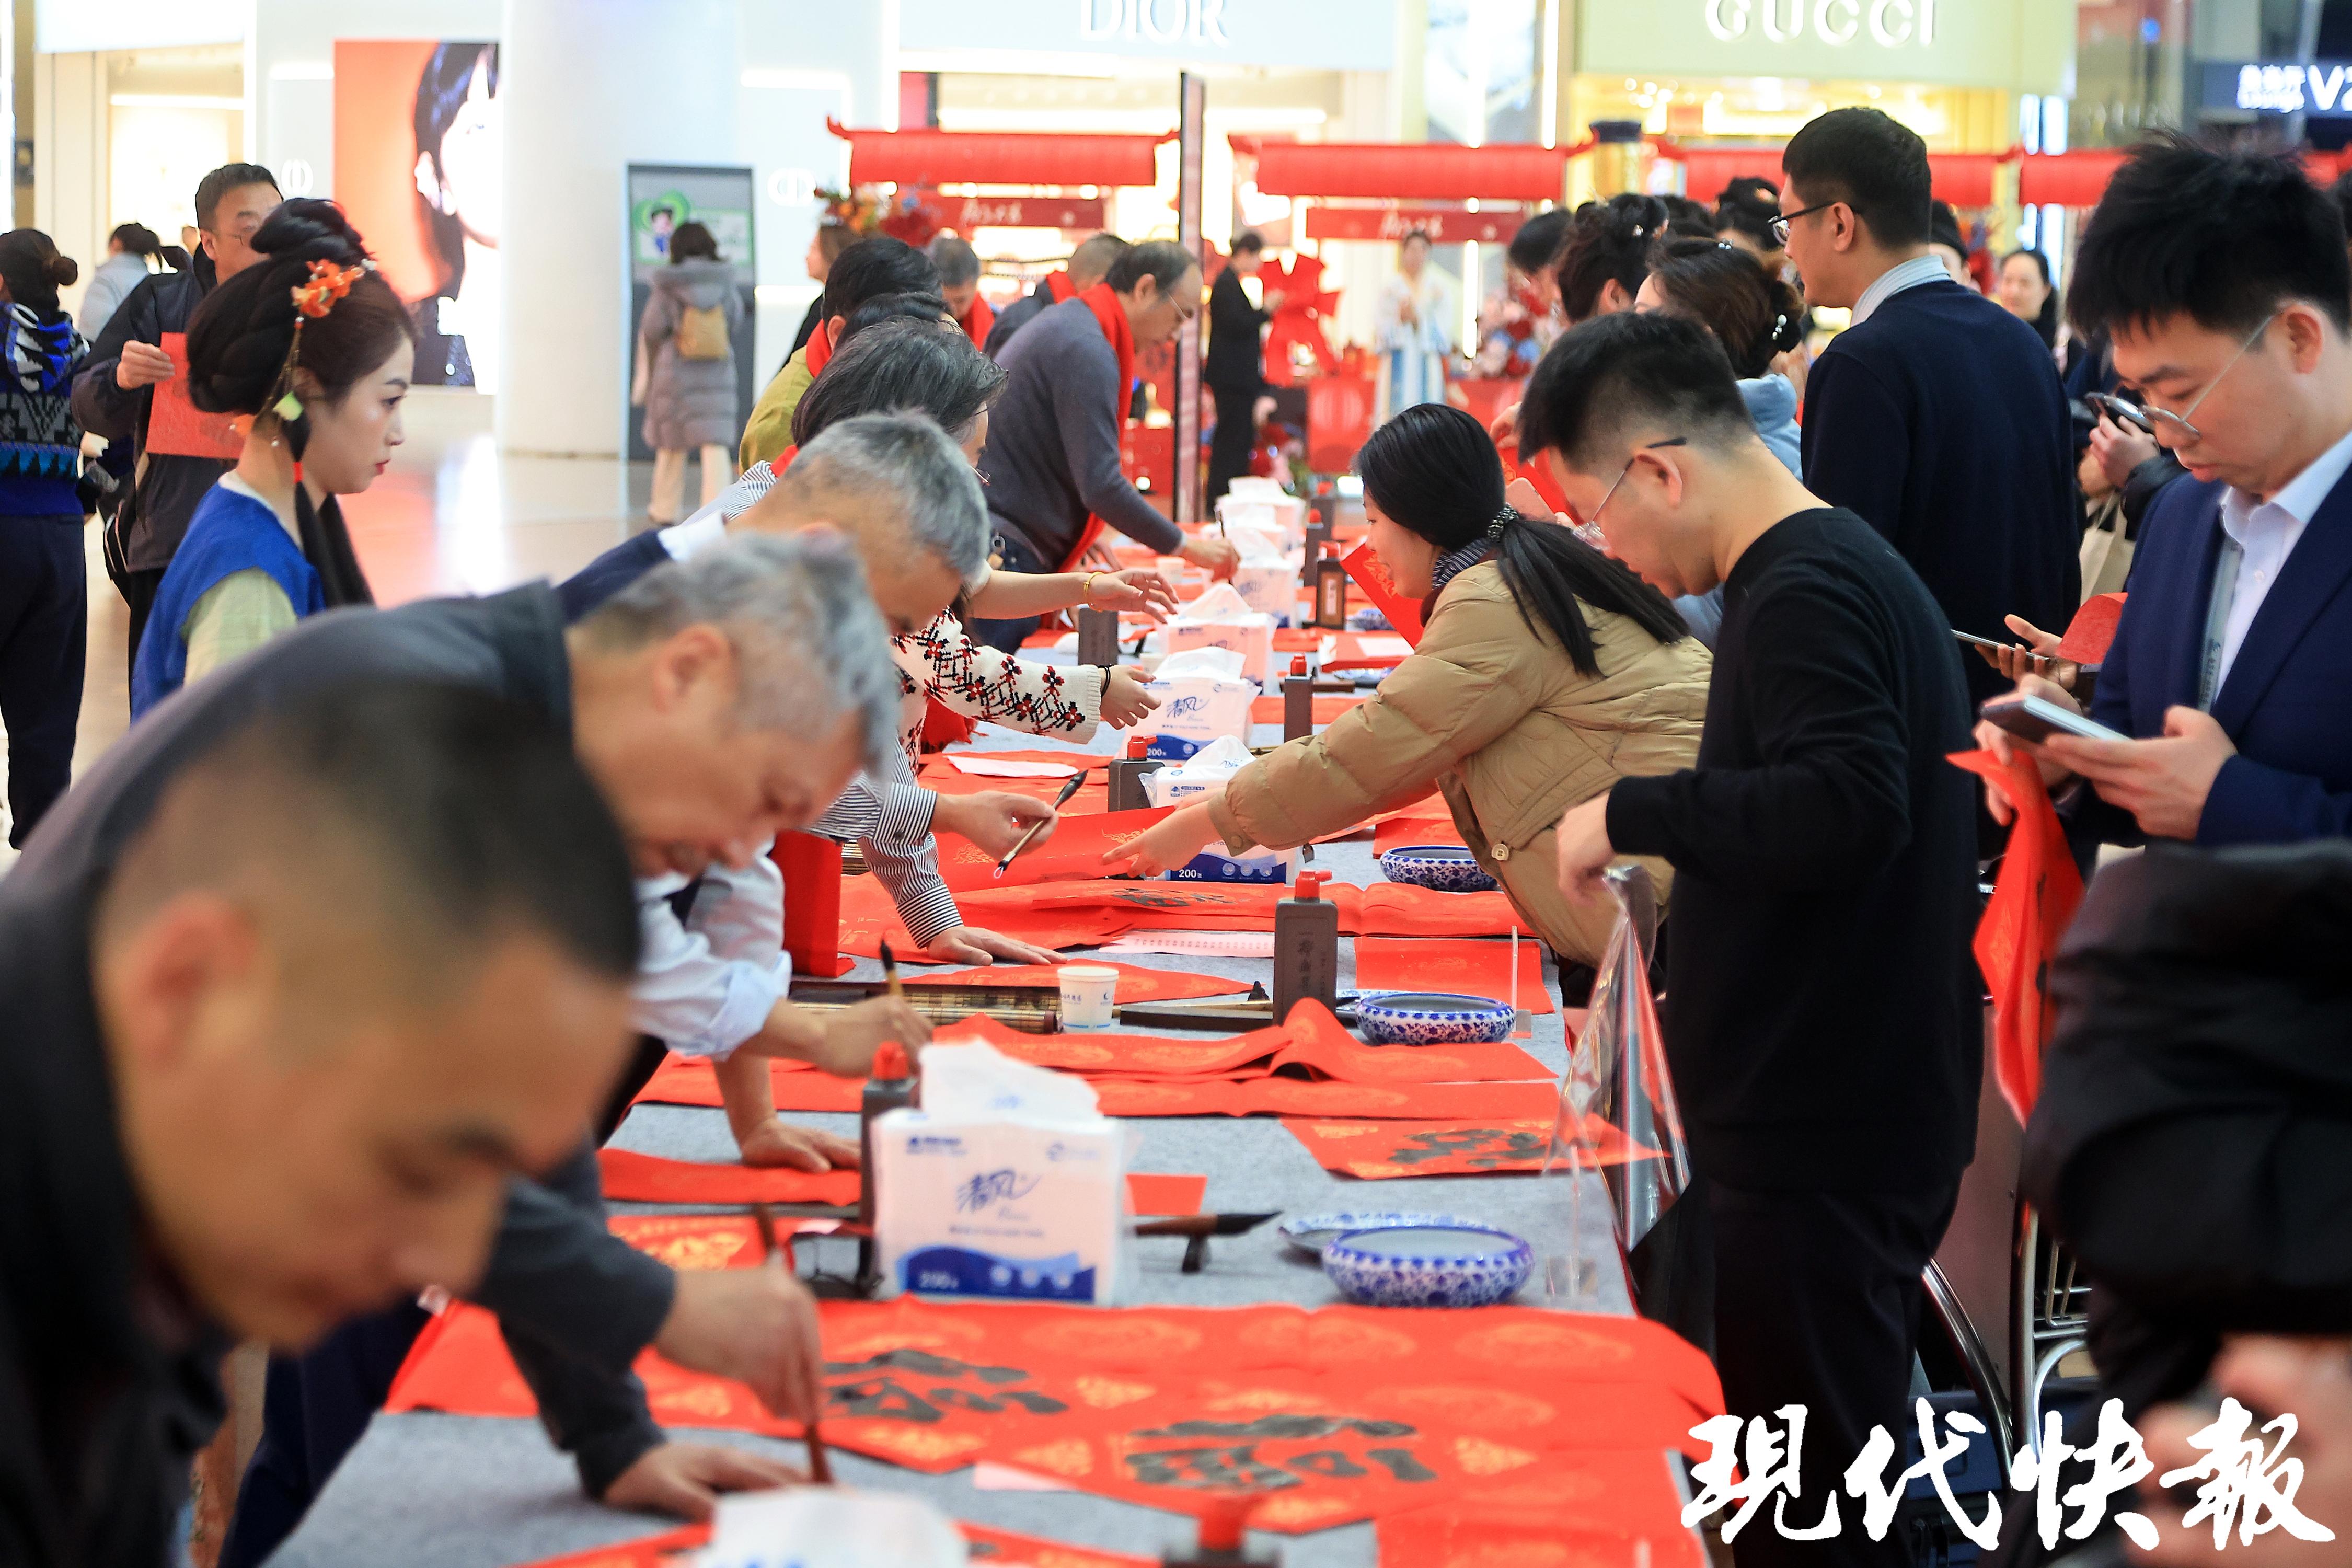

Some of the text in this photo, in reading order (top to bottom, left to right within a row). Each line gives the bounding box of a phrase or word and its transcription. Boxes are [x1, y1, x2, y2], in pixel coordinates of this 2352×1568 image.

[1079, 0, 1231, 47] DIOR
[1705, 0, 1935, 48] GUCCI
[1167, 696, 1212, 719] 清风
[1123, 1413, 1437, 1493] 福
